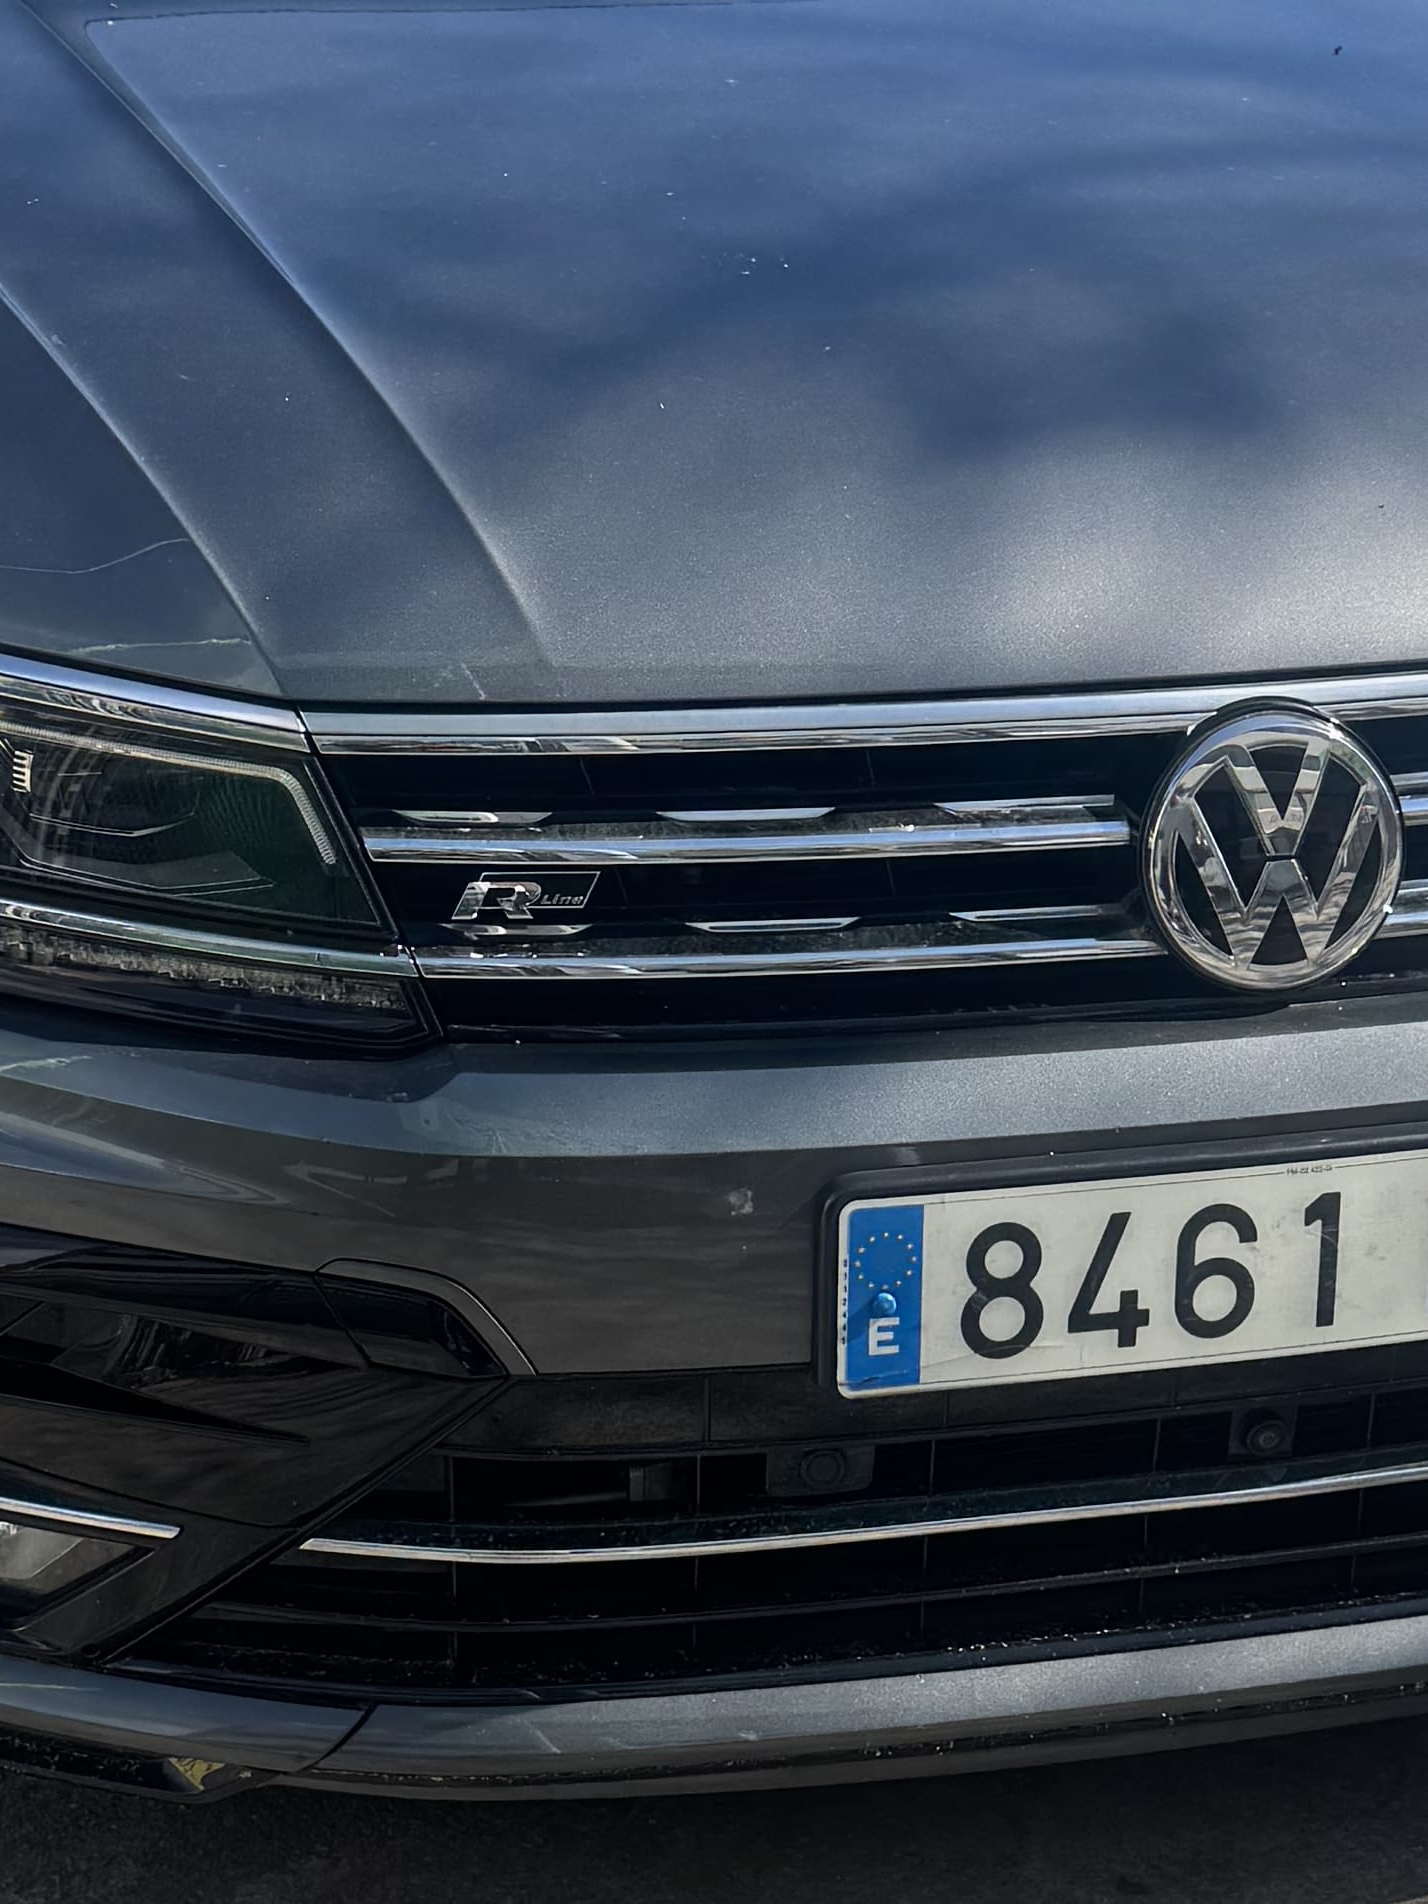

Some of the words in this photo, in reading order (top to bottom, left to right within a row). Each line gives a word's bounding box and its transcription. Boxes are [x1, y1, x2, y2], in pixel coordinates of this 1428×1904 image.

[451, 881, 541, 920] R
[541, 893, 583, 905] Line
[960, 1191, 1342, 1360] 8461
[868, 1316, 901, 1357] E
